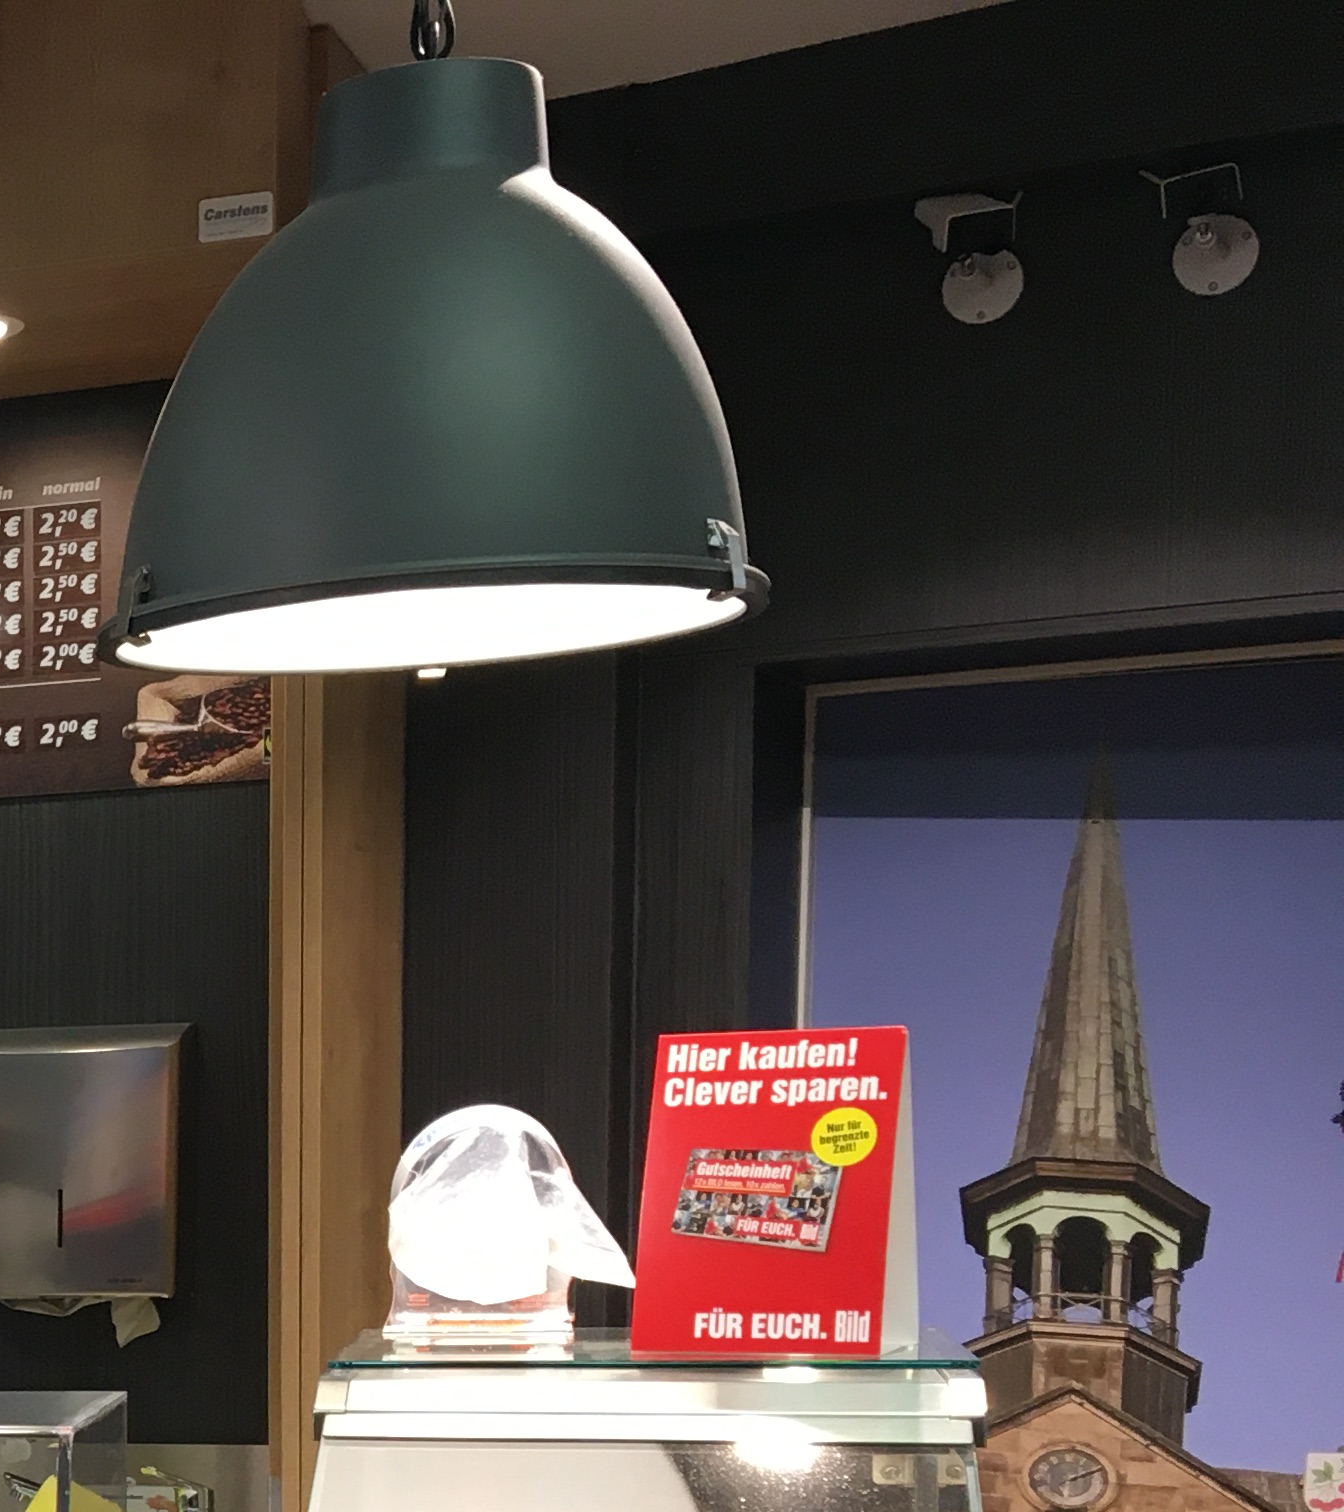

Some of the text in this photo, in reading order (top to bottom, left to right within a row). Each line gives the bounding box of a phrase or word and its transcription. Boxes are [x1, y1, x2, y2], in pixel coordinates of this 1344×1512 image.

[203, 203, 270, 222] Carstens
[42, 476, 102, 496] normal
[667, 1038, 859, 1073] Hier kaufen!
[664, 1075, 888, 1107] Clever sparen.
[826, 1120, 862, 1134] Nur für
[819, 1130, 870, 1146] begrenzte
[696, 1161, 793, 1180] Gutscheinheft
[736, 1218, 758, 1233] FÜR
[761, 1222, 795, 1237] EUCH.
[693, 1307, 870, 1343] FÜR EUCH. Bild
